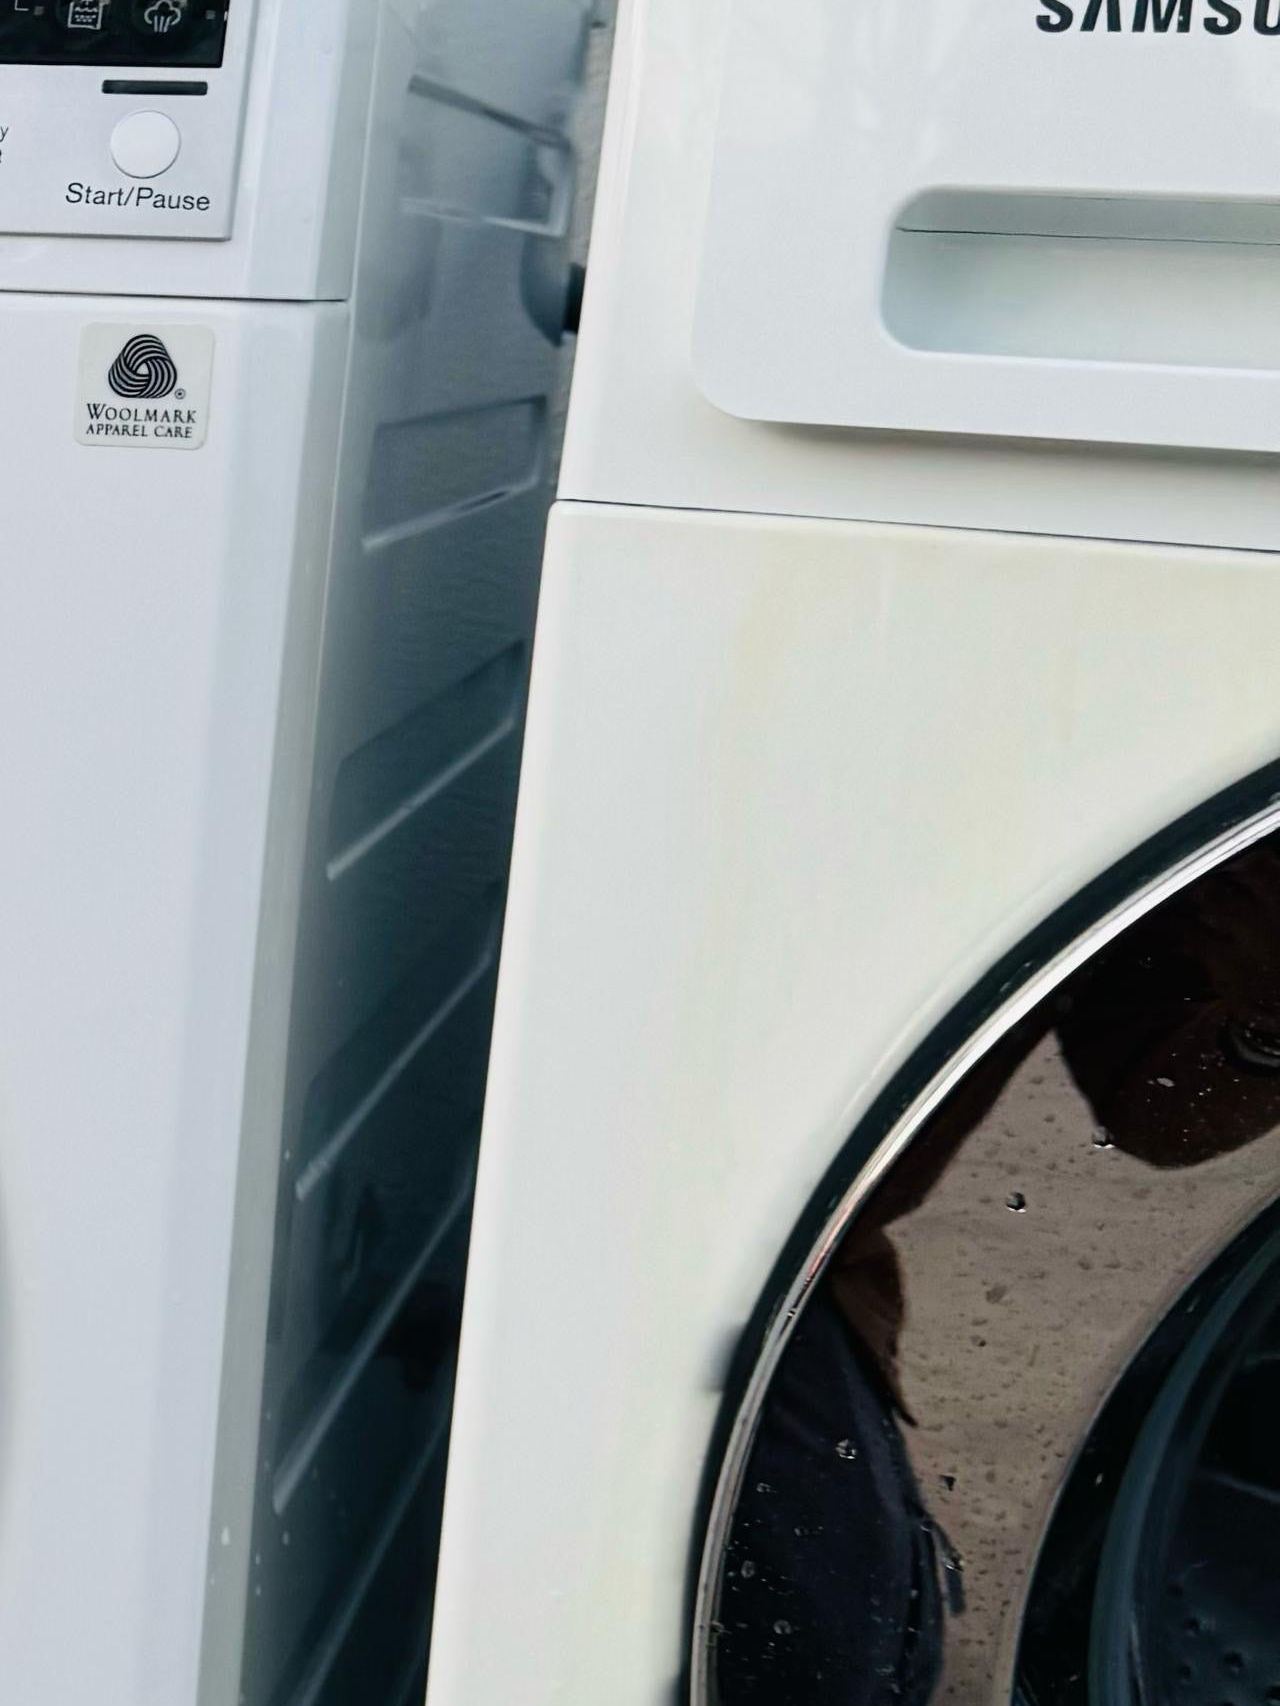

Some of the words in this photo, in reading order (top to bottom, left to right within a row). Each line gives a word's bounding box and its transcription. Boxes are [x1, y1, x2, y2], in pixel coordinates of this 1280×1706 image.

[65, 183, 210, 211] Start/Pause
[87, 403, 196, 423] WOOLMARK
[86, 424, 148, 437] APPAREL
[154, 426, 192, 438] CARE
